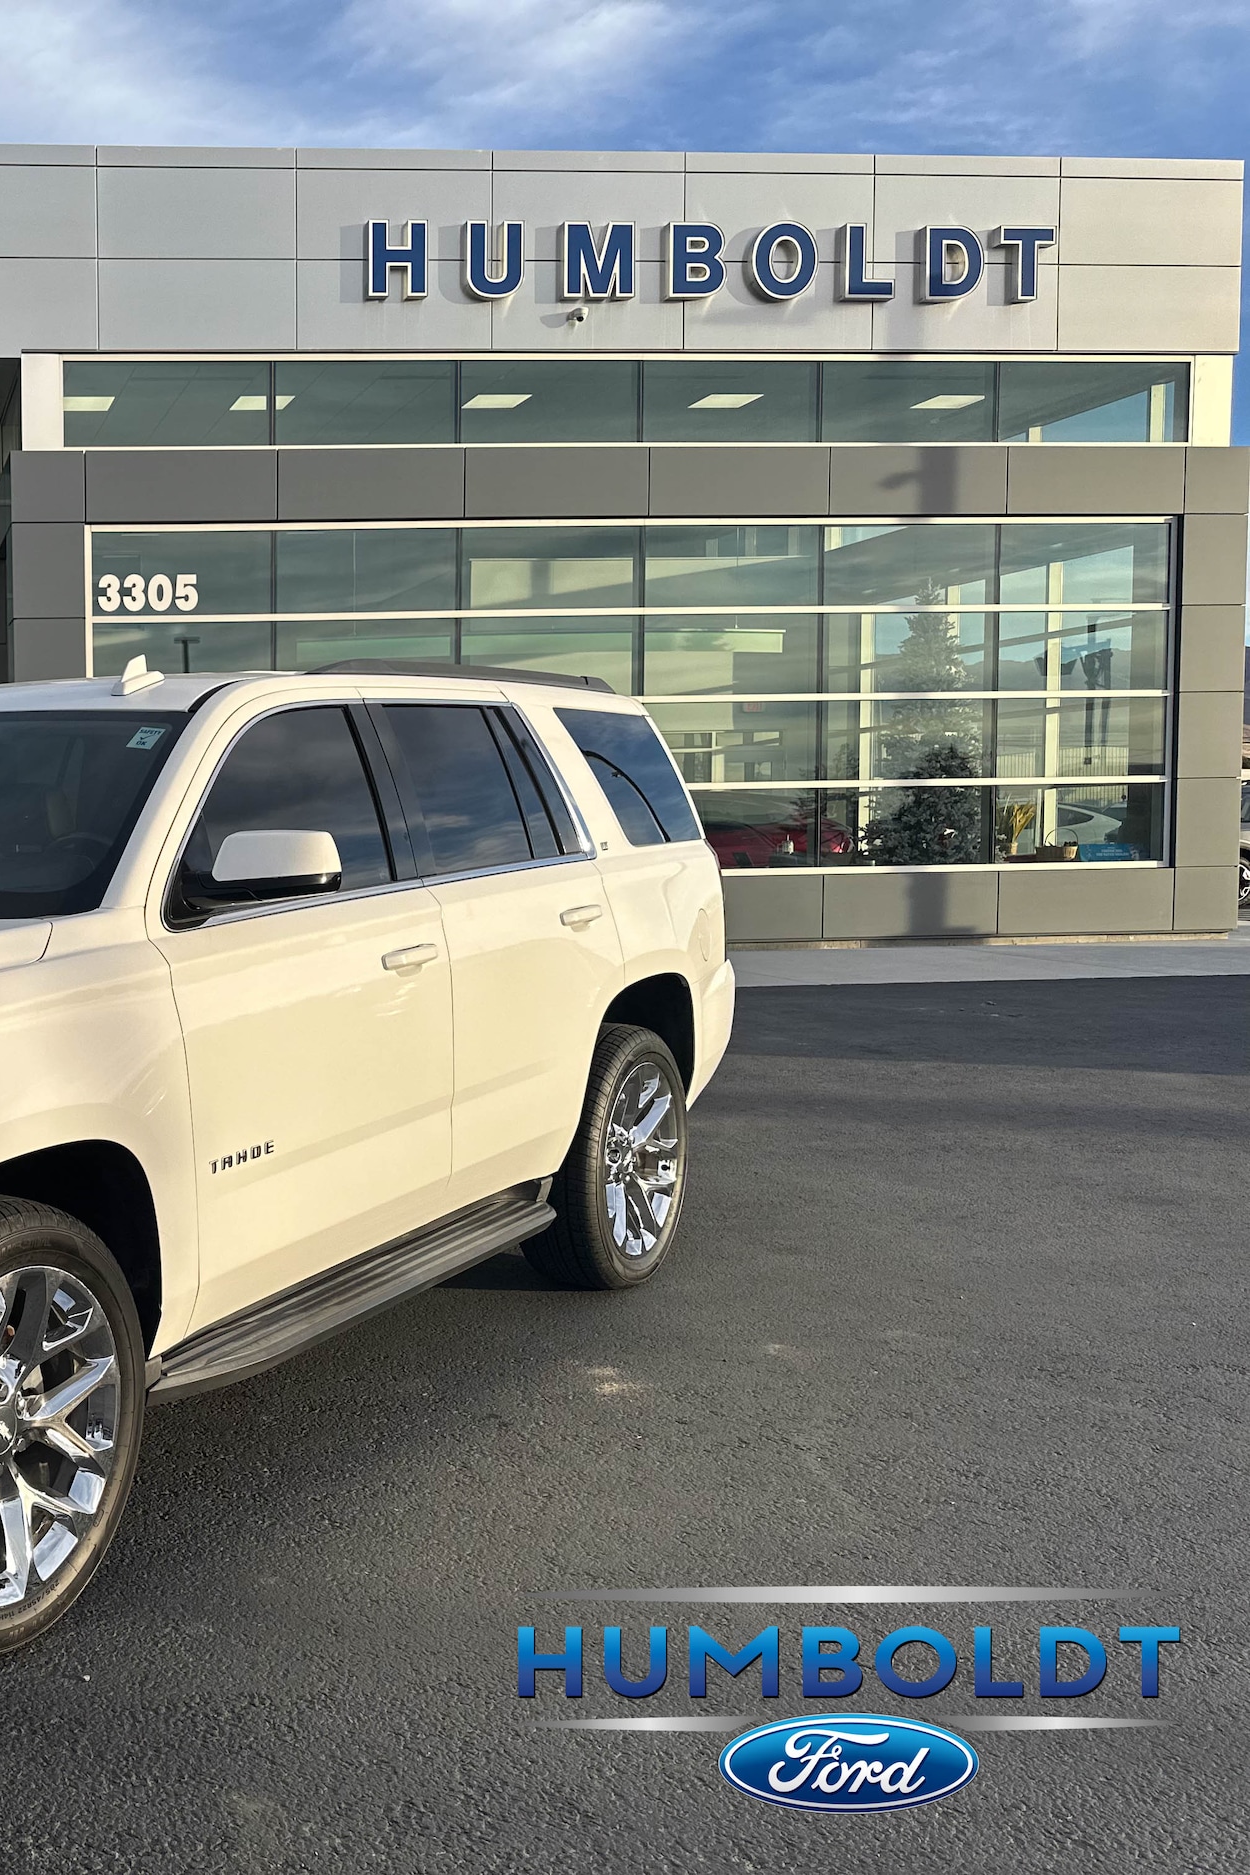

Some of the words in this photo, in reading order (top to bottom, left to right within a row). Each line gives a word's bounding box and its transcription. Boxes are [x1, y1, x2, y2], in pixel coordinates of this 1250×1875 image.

[367, 219, 1057, 303] HUMBOLDT
[97, 573, 199, 612] 3305
[209, 1139, 274, 1175] TAHOE
